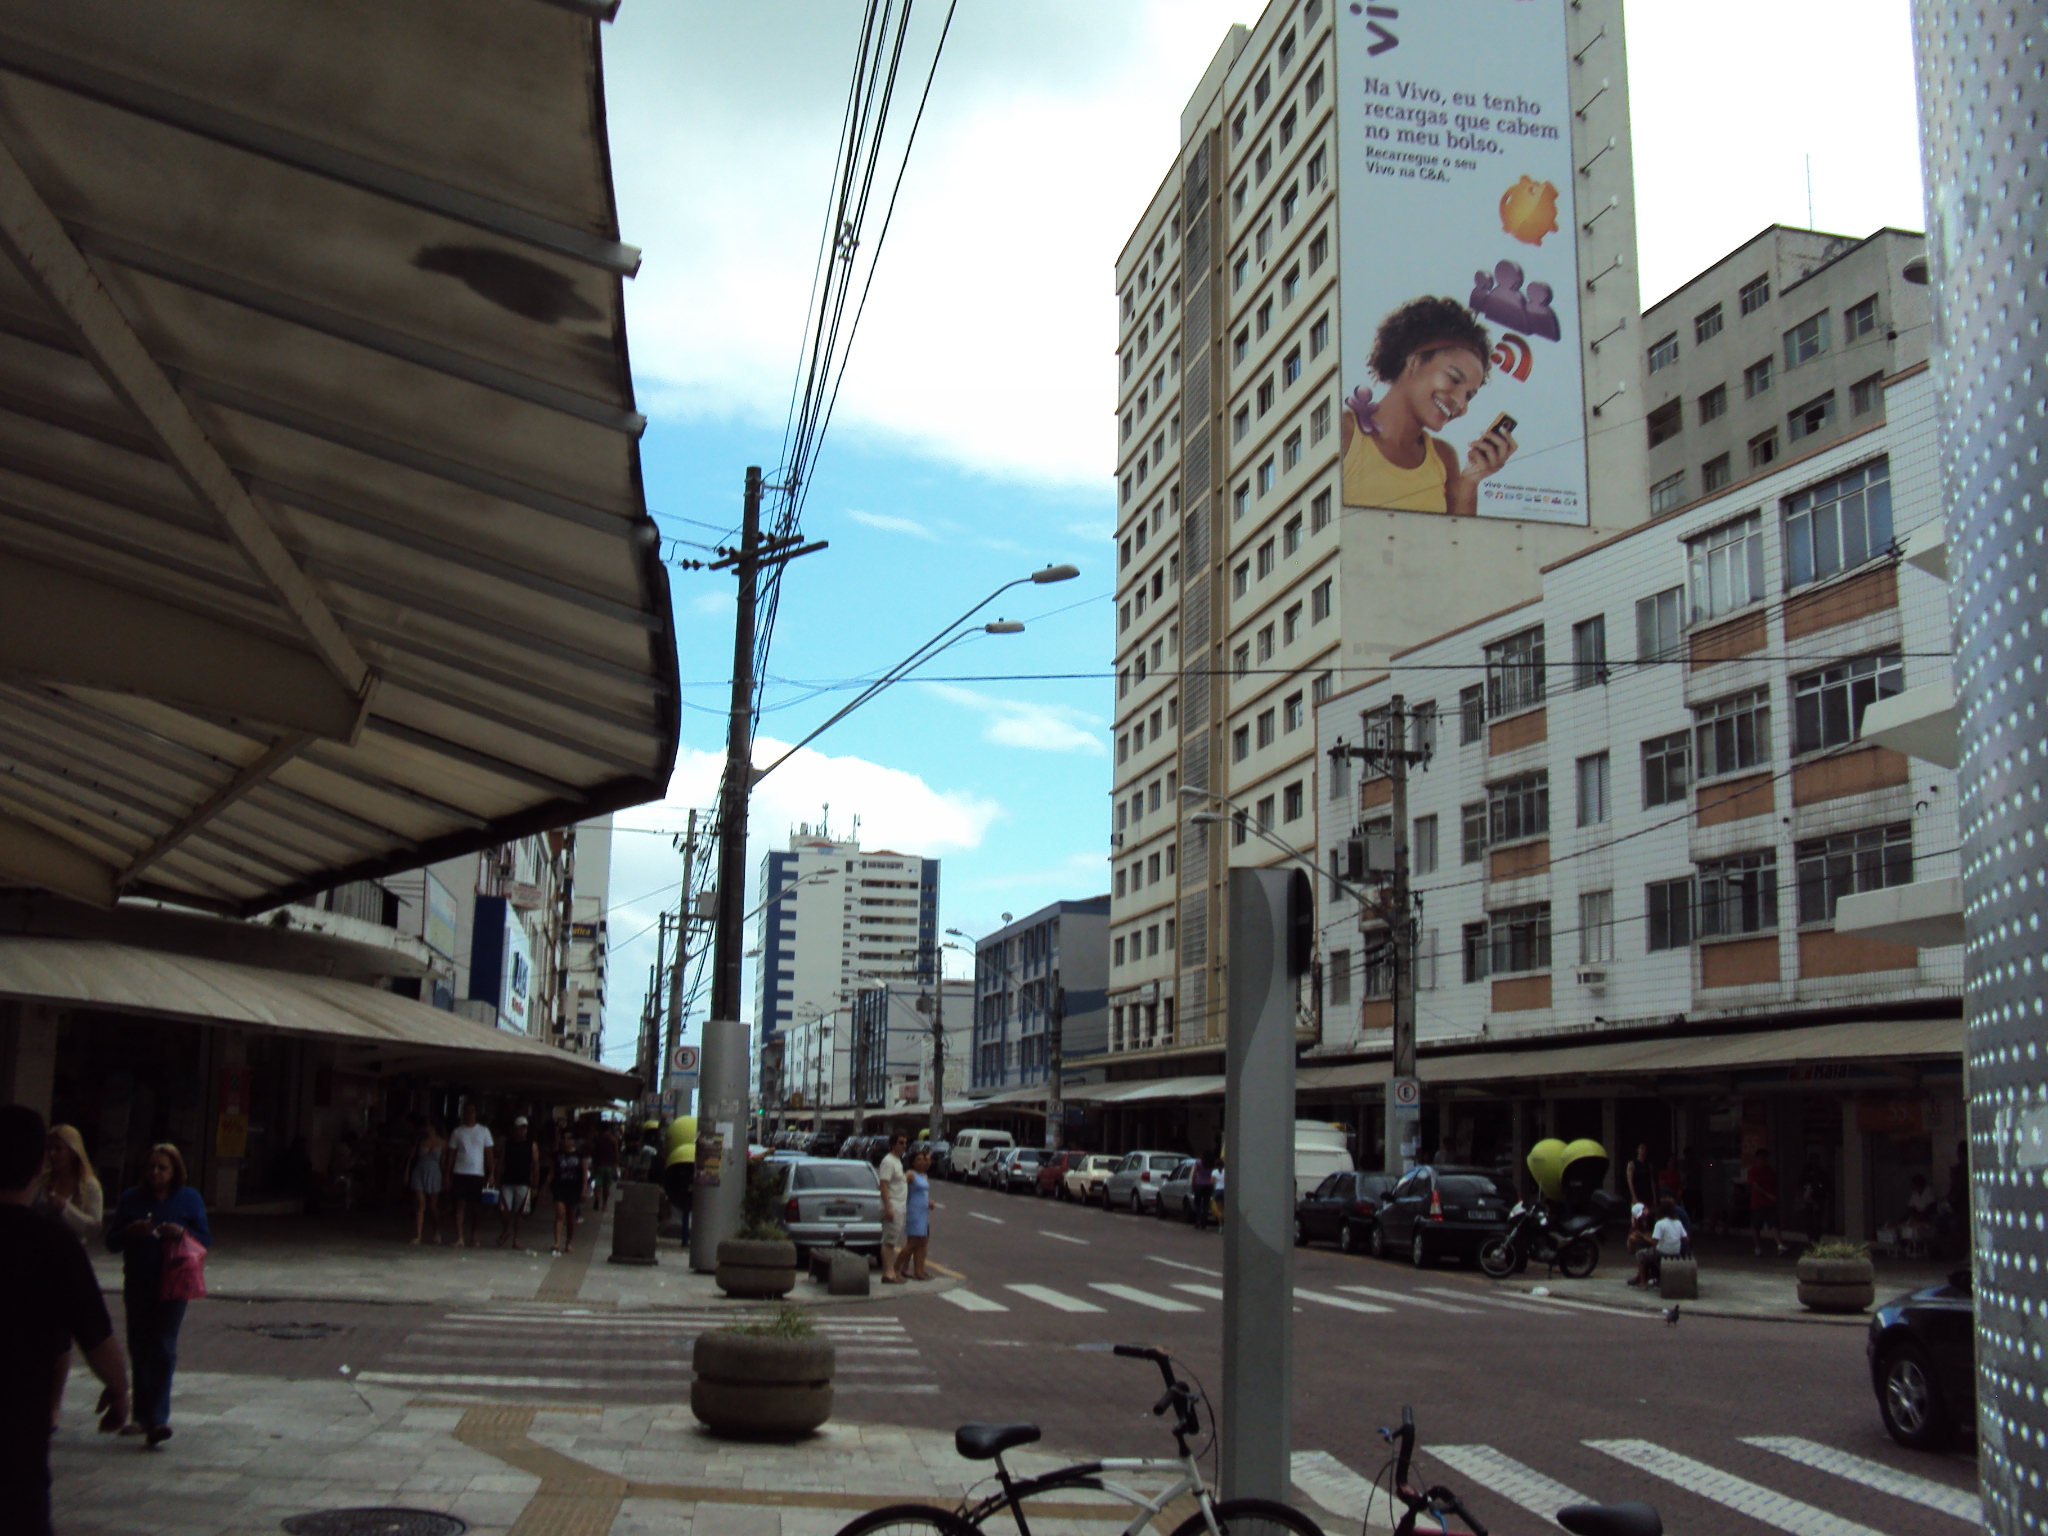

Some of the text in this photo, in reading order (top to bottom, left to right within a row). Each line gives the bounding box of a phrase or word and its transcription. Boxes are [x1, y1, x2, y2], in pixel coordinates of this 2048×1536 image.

[1349, 0, 1399, 57] vi
[1364, 76, 1541, 116] Na Vivo, eu tenho
[1364, 102, 1560, 140] recargas que cabem
[1364, 123, 1505, 155] no meu bolso.
[1366, 145, 1478, 170] Recarregue o seu
[1366, 160, 1451, 183] Vivo na C&A.
[681, 1052, 690, 1066] E
[1403, 1087, 1411, 1099] E
